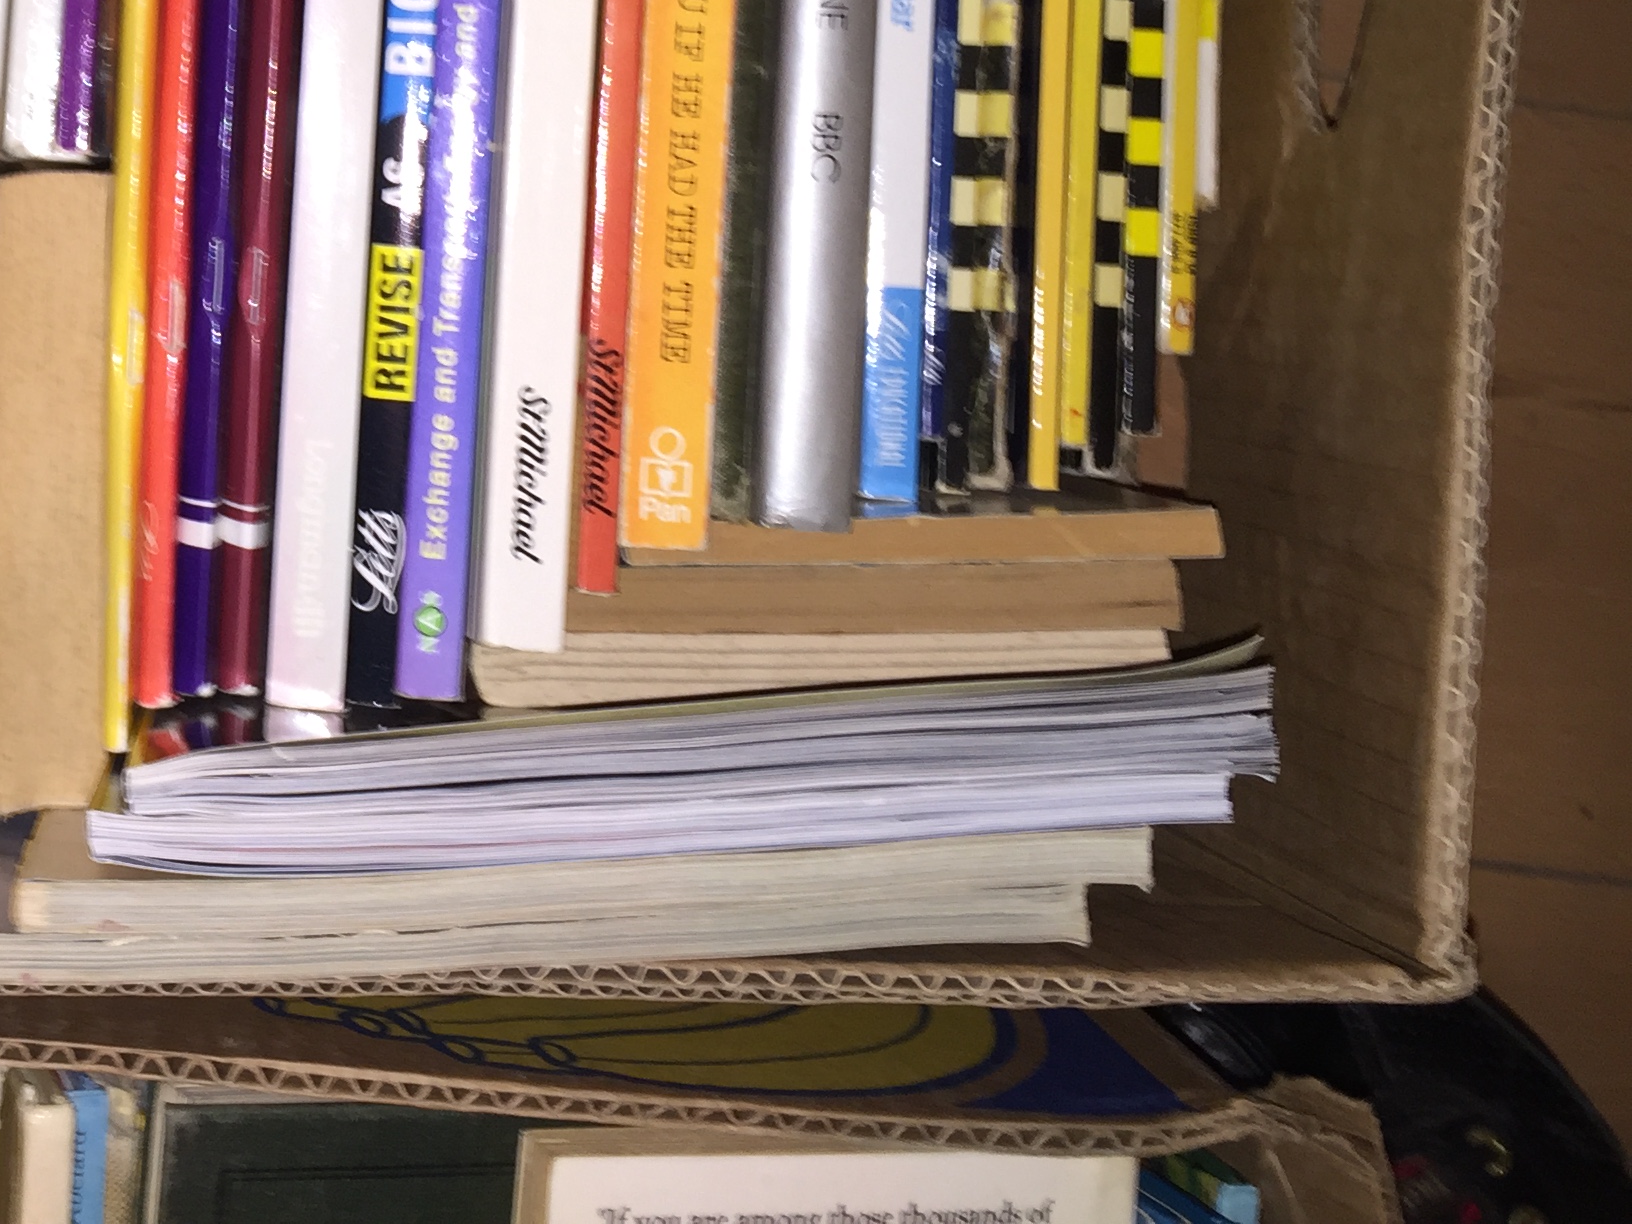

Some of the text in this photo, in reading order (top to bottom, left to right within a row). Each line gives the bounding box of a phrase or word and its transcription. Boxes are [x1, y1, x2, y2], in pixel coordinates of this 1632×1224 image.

[453, 3, 480, 59] and
[673, 21, 705, 62] IF
[670, 72, 704, 119] HE
[667, 128, 701, 197] HAD
[810, 110, 845, 186] BBC
[663, 203, 700, 269] THE
[374, 249, 415, 392] REVISE
[658, 280, 696, 364] TIME
[428, 347, 460, 404] and
[418, 413, 459, 562] Exchange
[350, 508, 408, 616] Letts
